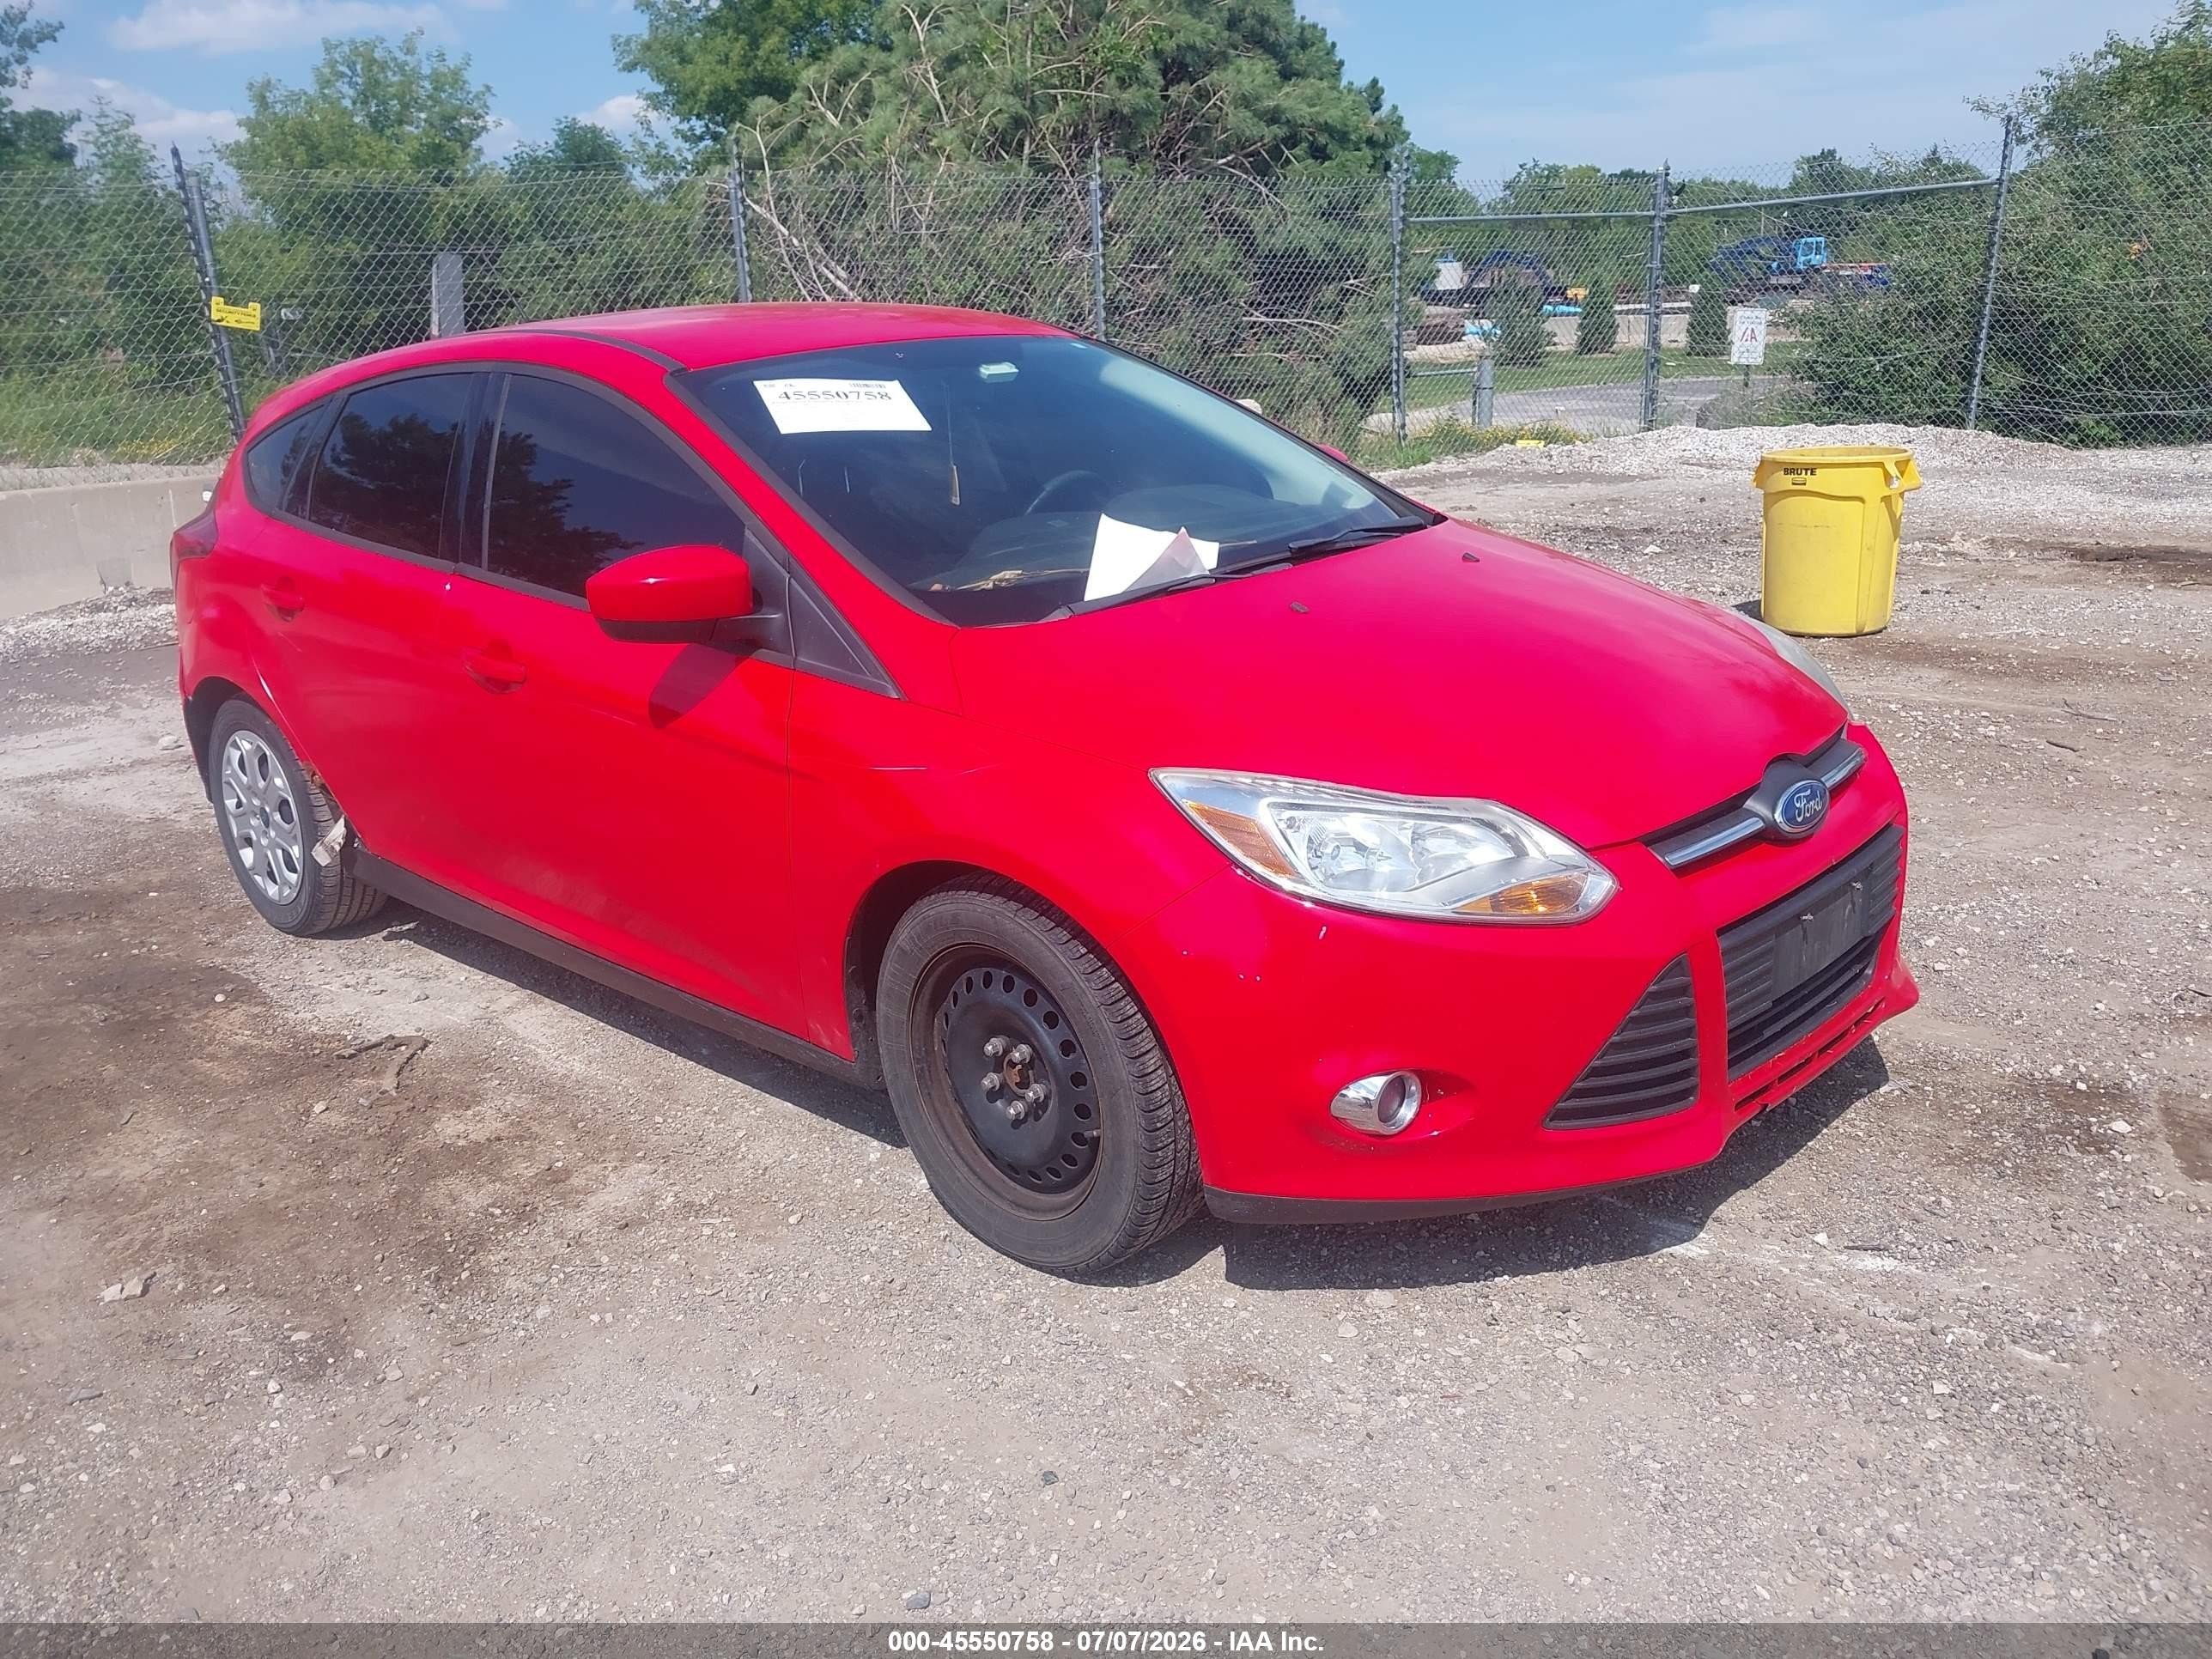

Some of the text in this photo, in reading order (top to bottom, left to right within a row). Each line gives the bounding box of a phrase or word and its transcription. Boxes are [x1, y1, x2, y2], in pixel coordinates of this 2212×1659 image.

[778, 391, 892, 400] 45550758
[1784, 467, 1817, 476] BRUTE
[1793, 788, 1823, 823] Ford
